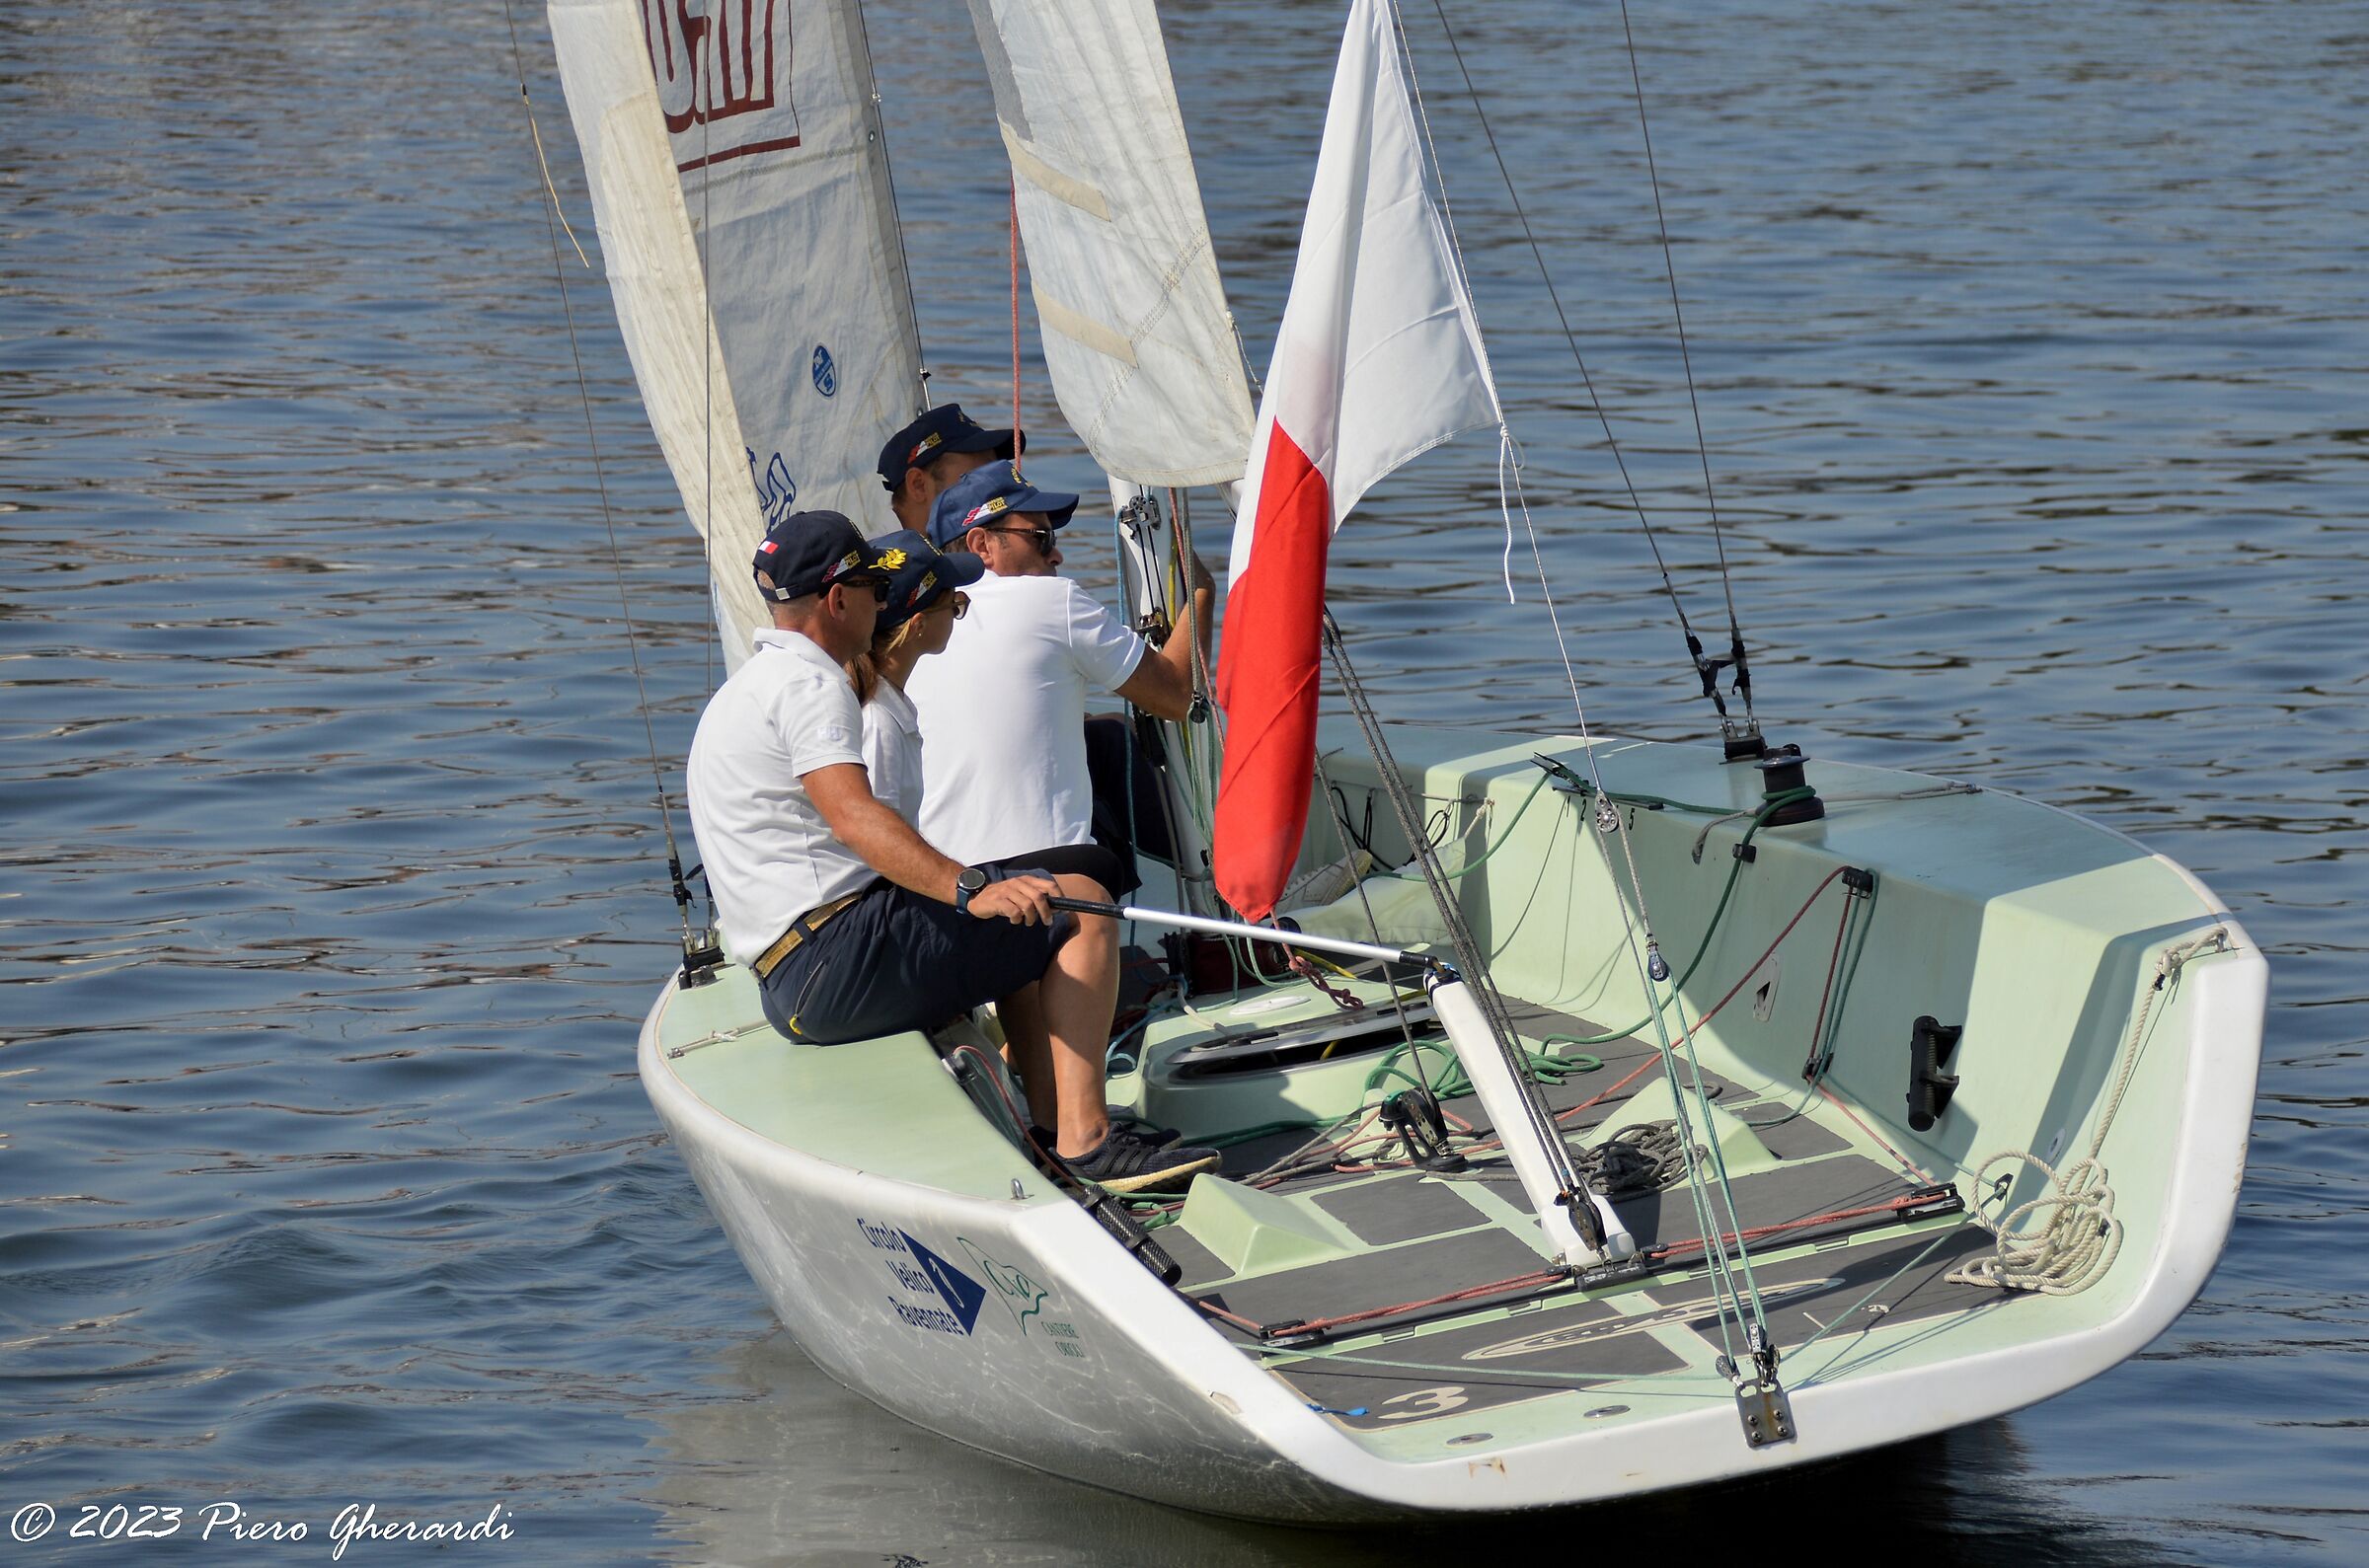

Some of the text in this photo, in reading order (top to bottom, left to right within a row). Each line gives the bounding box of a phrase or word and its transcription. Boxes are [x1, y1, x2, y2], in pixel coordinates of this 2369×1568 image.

[857, 1218, 907, 1253] Circolo
[885, 1259, 935, 1295] Velico
[887, 1296, 964, 1335] Ravennate
[1378, 1386, 1469, 1419] 3
